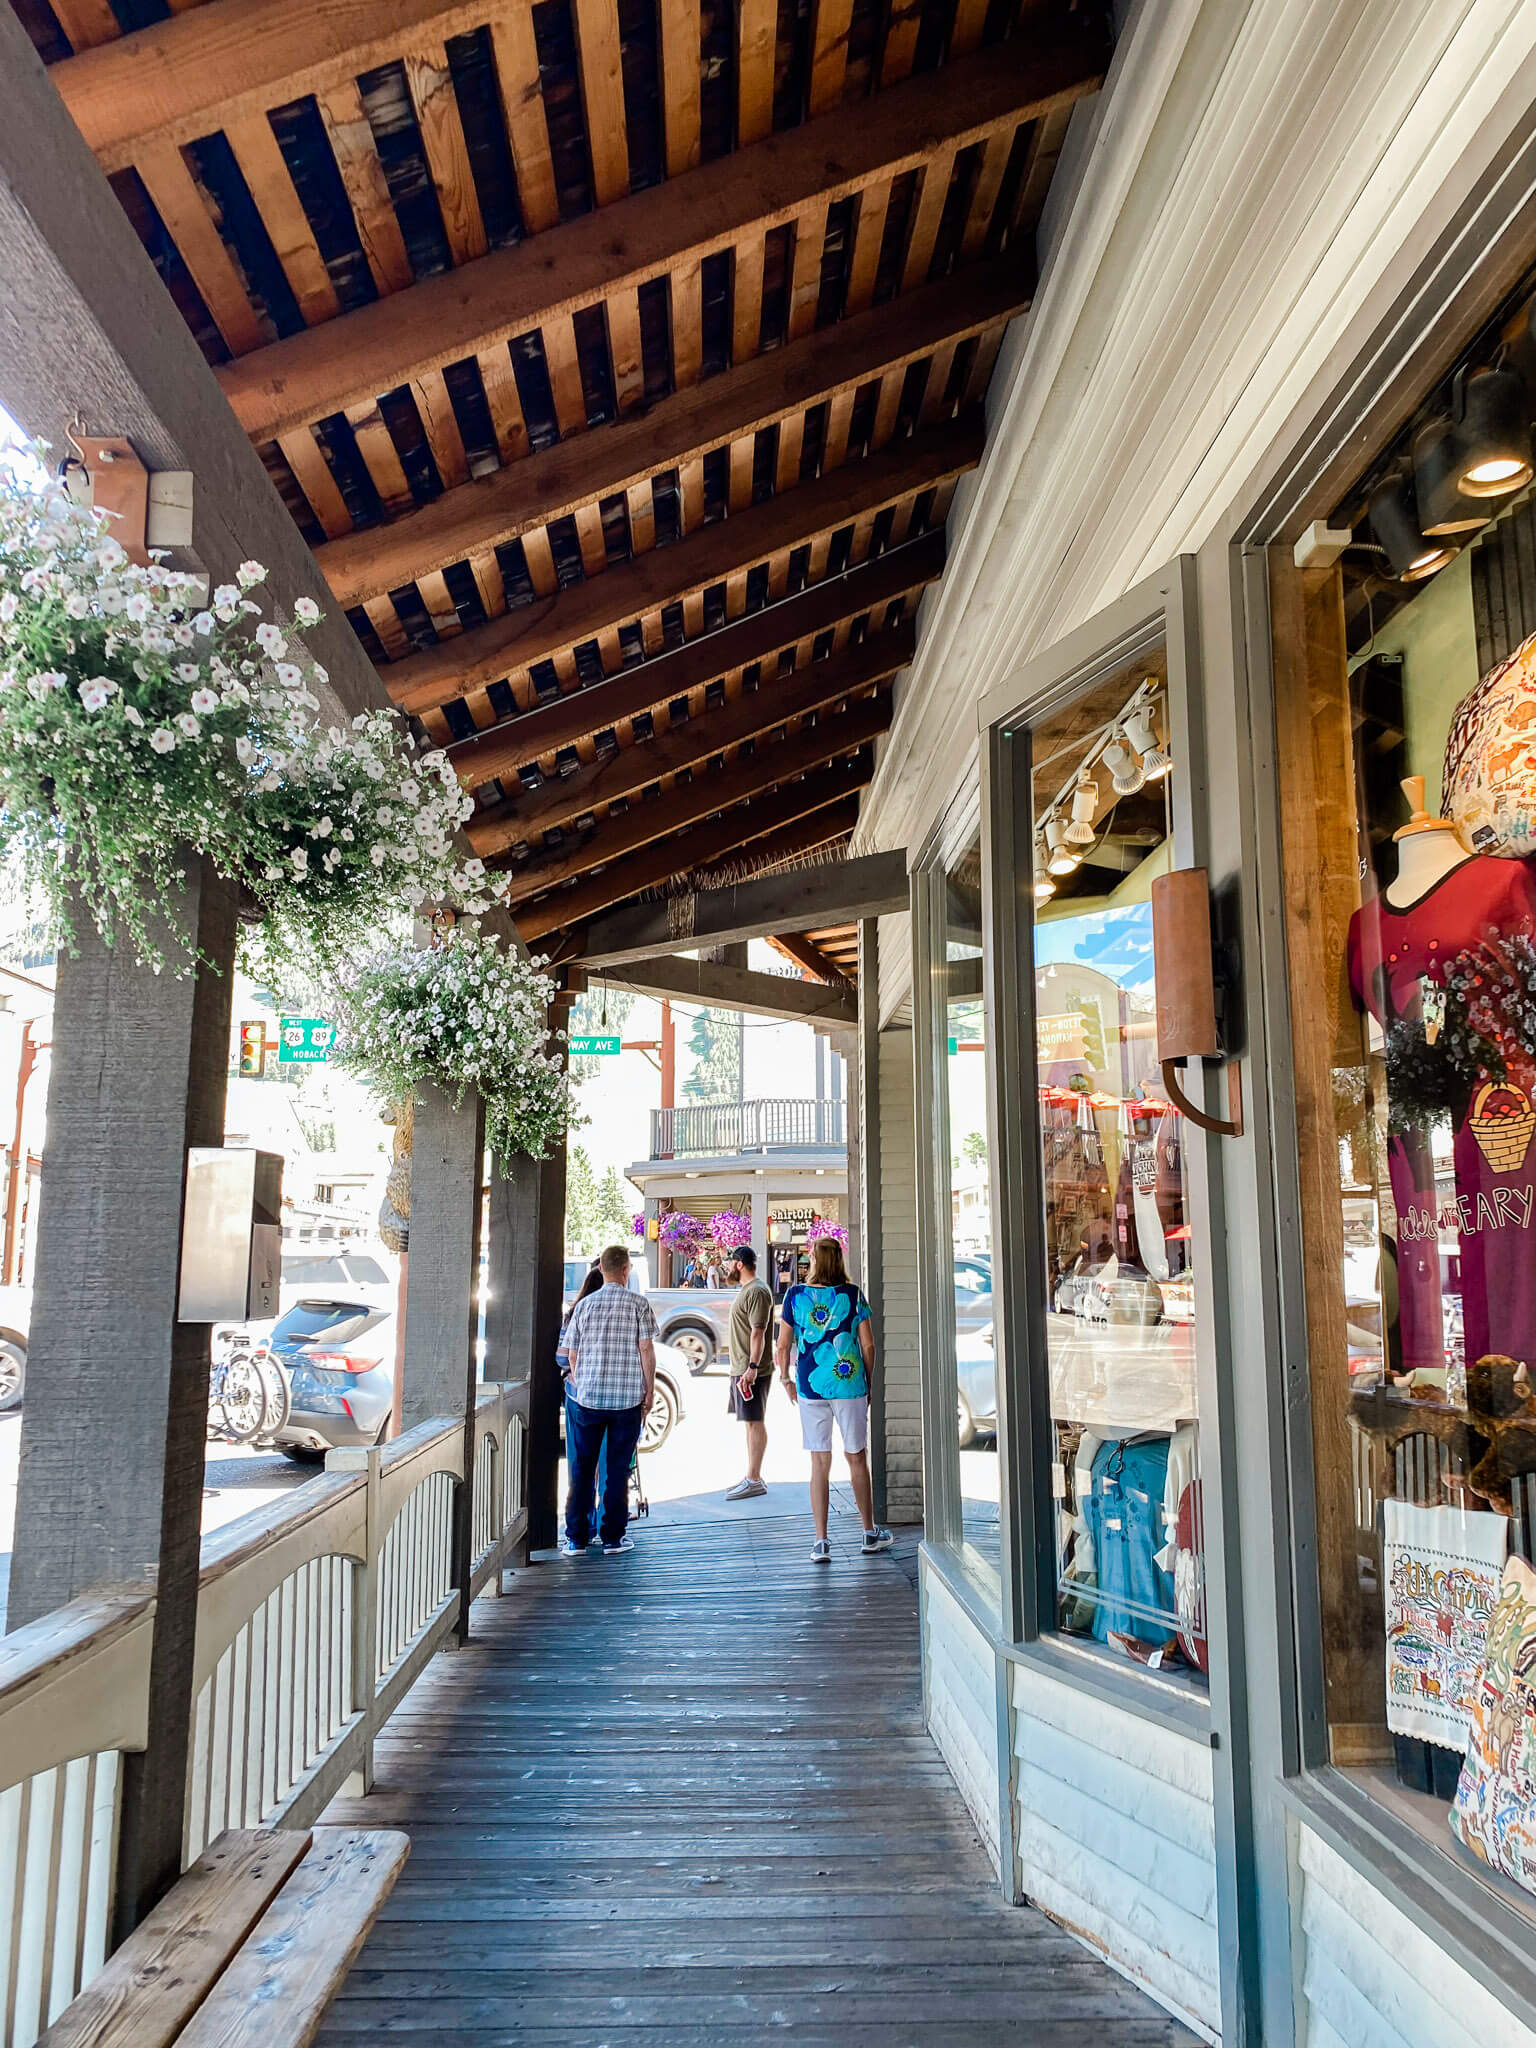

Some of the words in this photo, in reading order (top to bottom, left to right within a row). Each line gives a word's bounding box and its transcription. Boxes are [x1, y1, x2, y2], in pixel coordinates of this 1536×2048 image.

[289, 1031, 300, 1041] 26
[315, 1031, 327, 1041] 89
[569, 1041, 590, 1050] WAY
[594, 1041, 614, 1050] AVE
[790, 1219, 813, 1231] Back
